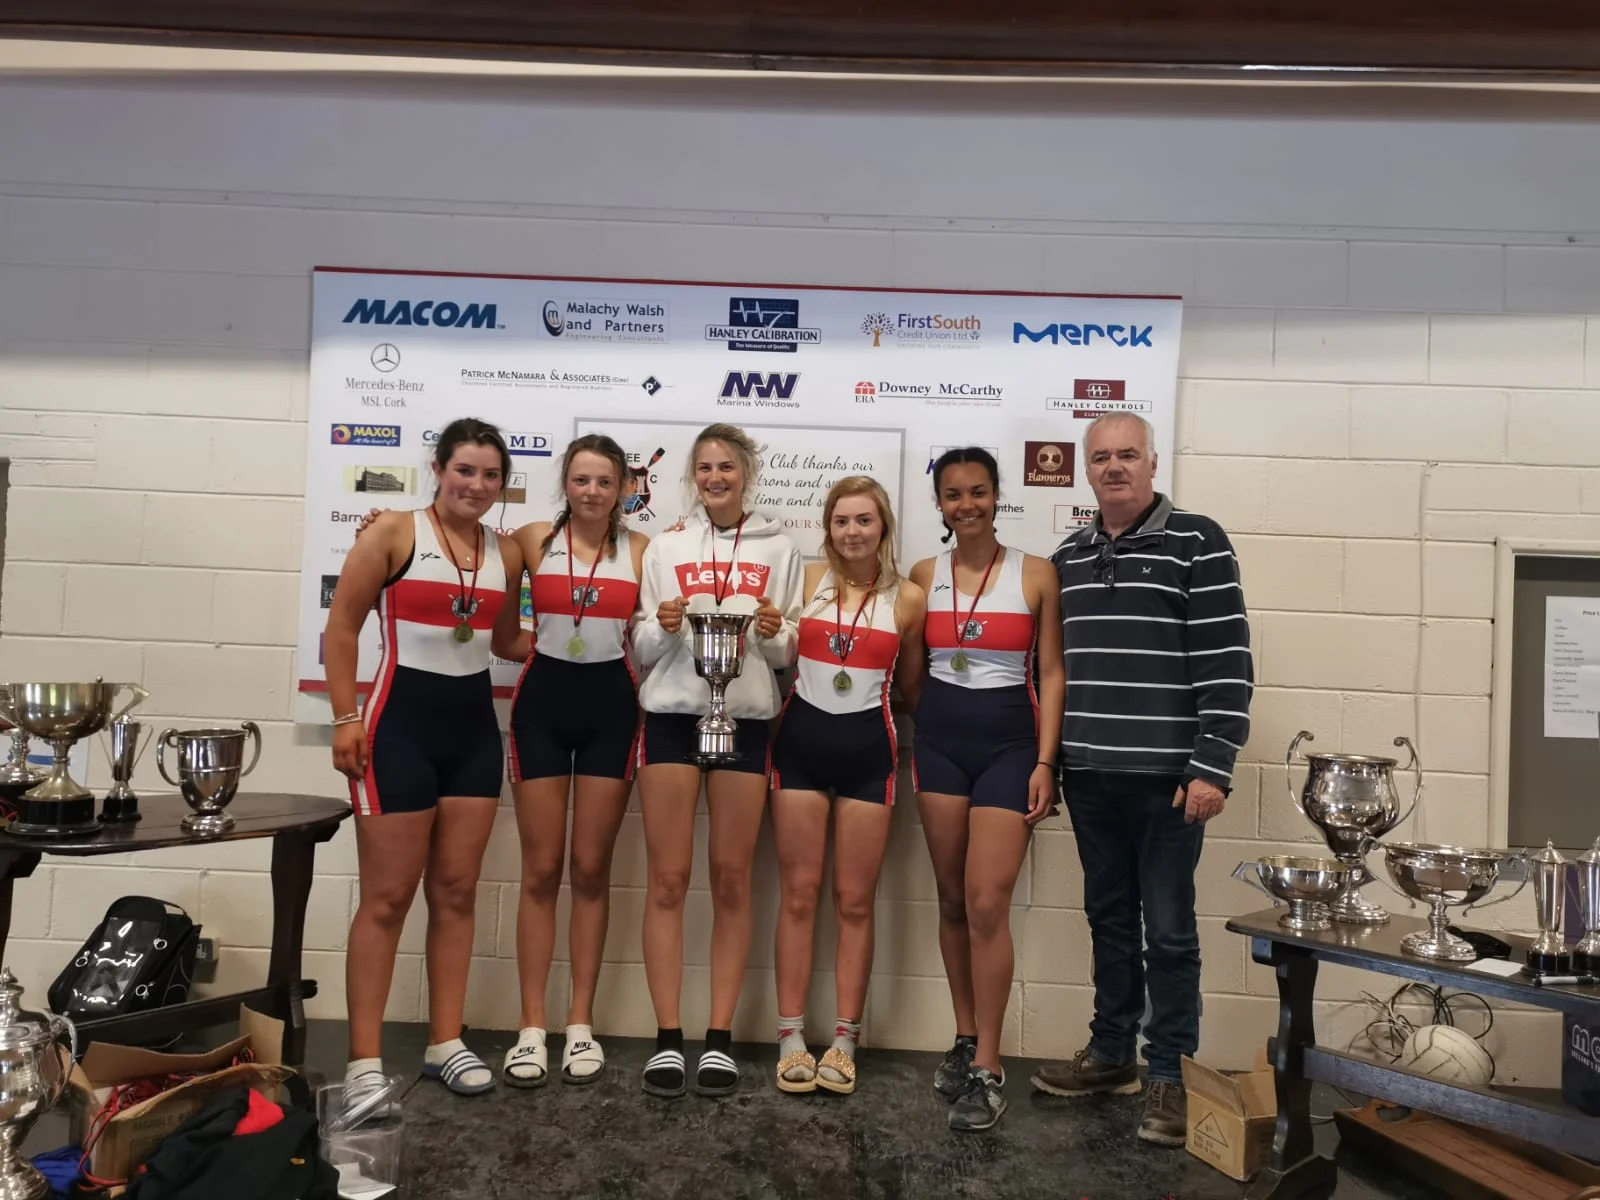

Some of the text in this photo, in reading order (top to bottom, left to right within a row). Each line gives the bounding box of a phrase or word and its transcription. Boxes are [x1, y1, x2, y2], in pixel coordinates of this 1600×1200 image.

[342, 299, 497, 329] MACOM
[566, 302, 664, 317] Malachy Walsh
[566, 319, 664, 333] and Partners
[709, 327, 817, 341] HANLEY CALIBRATION
[897, 330, 923, 340] Credit
[925, 332, 951, 340] Union
[550, 368, 561, 381] &
[345, 377, 425, 392] Mercedes-Benz
[879, 381, 1003, 398] Downey McCarthy
[361, 395, 407, 408] MSL Cork
[717, 399, 800, 408] Marina Windows
[1053, 401, 1145, 410] HANLEY CONTROLS
[353, 426, 398, 438] MAXOL
[626, 453, 641, 463] EE
[770, 453, 798, 470] Club
[802, 455, 847, 471] thanks
[852, 461, 876, 471] our
[795, 474, 822, 489] and
[754, 491, 782, 506] time
[787, 493, 813, 507] and
[784, 518, 812, 529] OUR
[574, 1041, 592, 1050] NIKE
